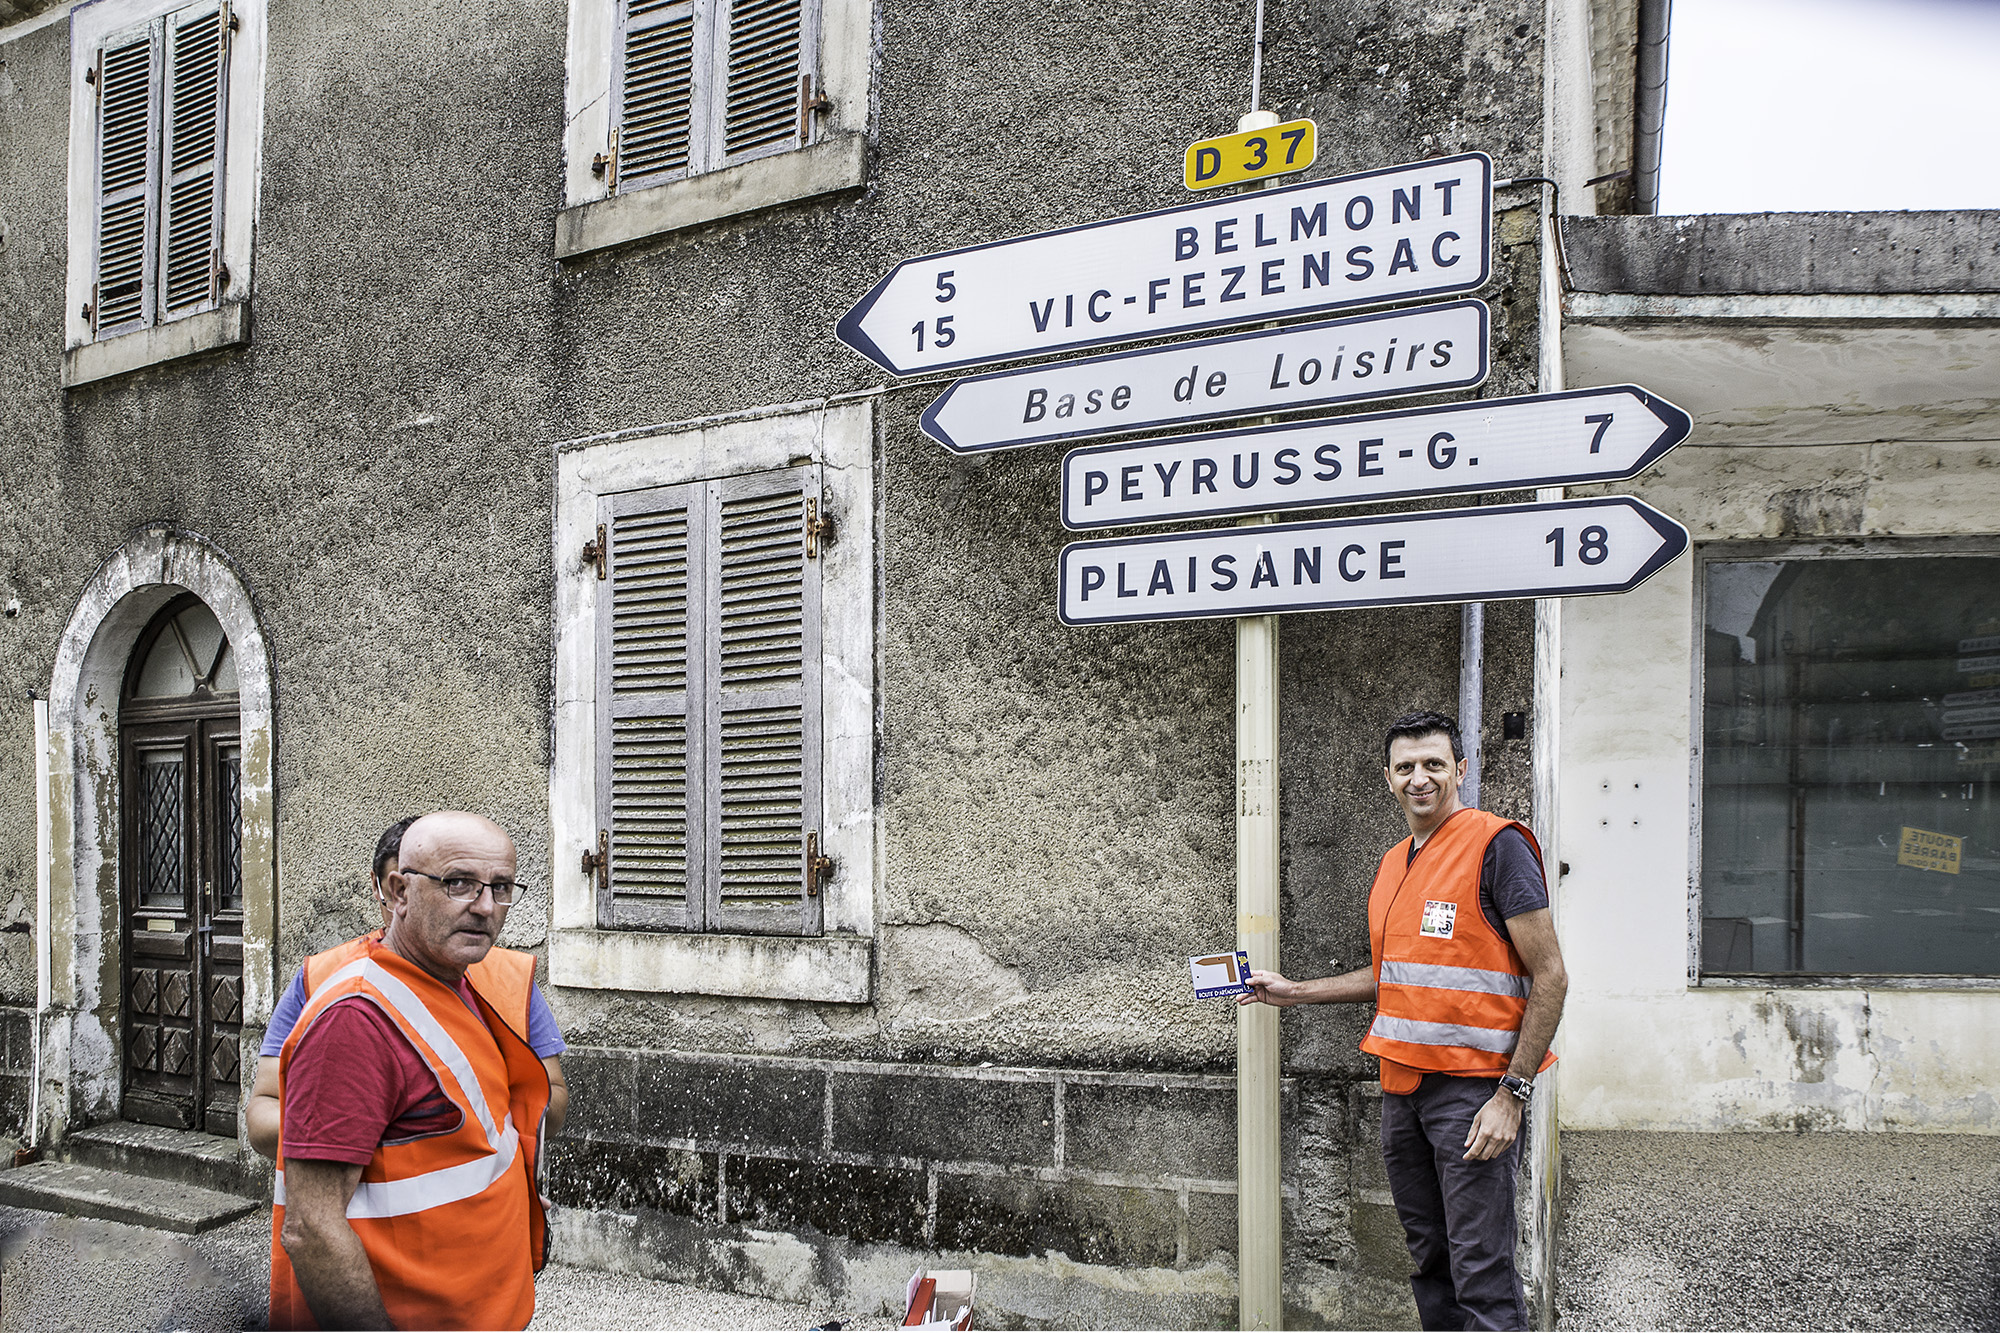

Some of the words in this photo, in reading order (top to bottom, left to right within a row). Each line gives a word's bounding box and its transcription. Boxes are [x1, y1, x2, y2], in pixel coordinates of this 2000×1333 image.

[1195, 146, 1222, 182] D
[1242, 127, 1306, 171] 37
[934, 270, 957, 304] 5
[1174, 178, 1461, 262] BELMONT
[911, 314, 956, 353] 15
[1029, 230, 1461, 334] VIC-FEZENSAC
[1022, 385, 1132, 424] Base
[1173, 364, 1227, 403] de
[1269, 337, 1454, 390] Loisirs
[1084, 431, 1479, 507] PEYRUSSE-G.
[1584, 412, 1614, 455] 7
[1080, 539, 1406, 602] PLAISANCE
[1545, 525, 1609, 568] 18
